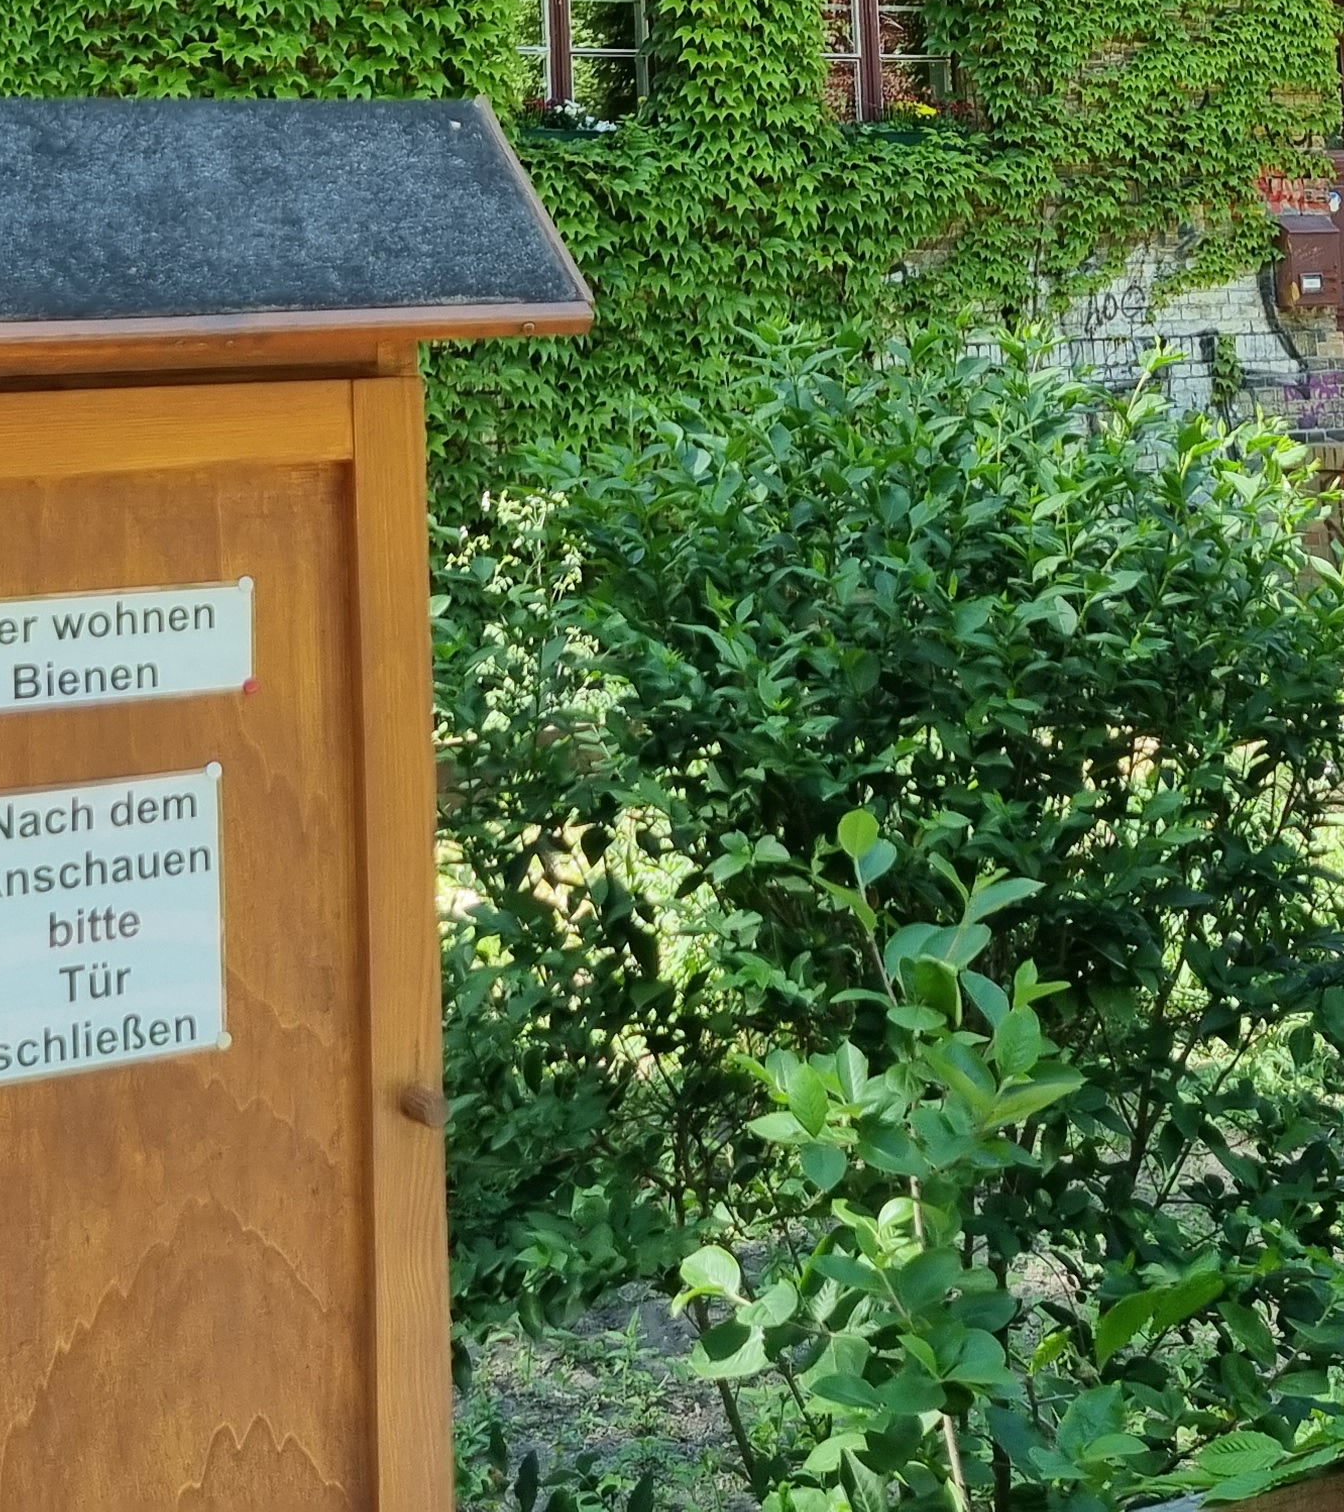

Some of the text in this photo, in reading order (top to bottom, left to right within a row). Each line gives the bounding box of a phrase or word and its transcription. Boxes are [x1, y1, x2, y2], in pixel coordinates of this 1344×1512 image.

[51, 600, 216, 641] wohnen
[13, 660, 159, 700] Bienen
[110, 790, 198, 827] dem
[49, 905, 141, 949] bitte
[58, 962, 132, 1002] Tür
